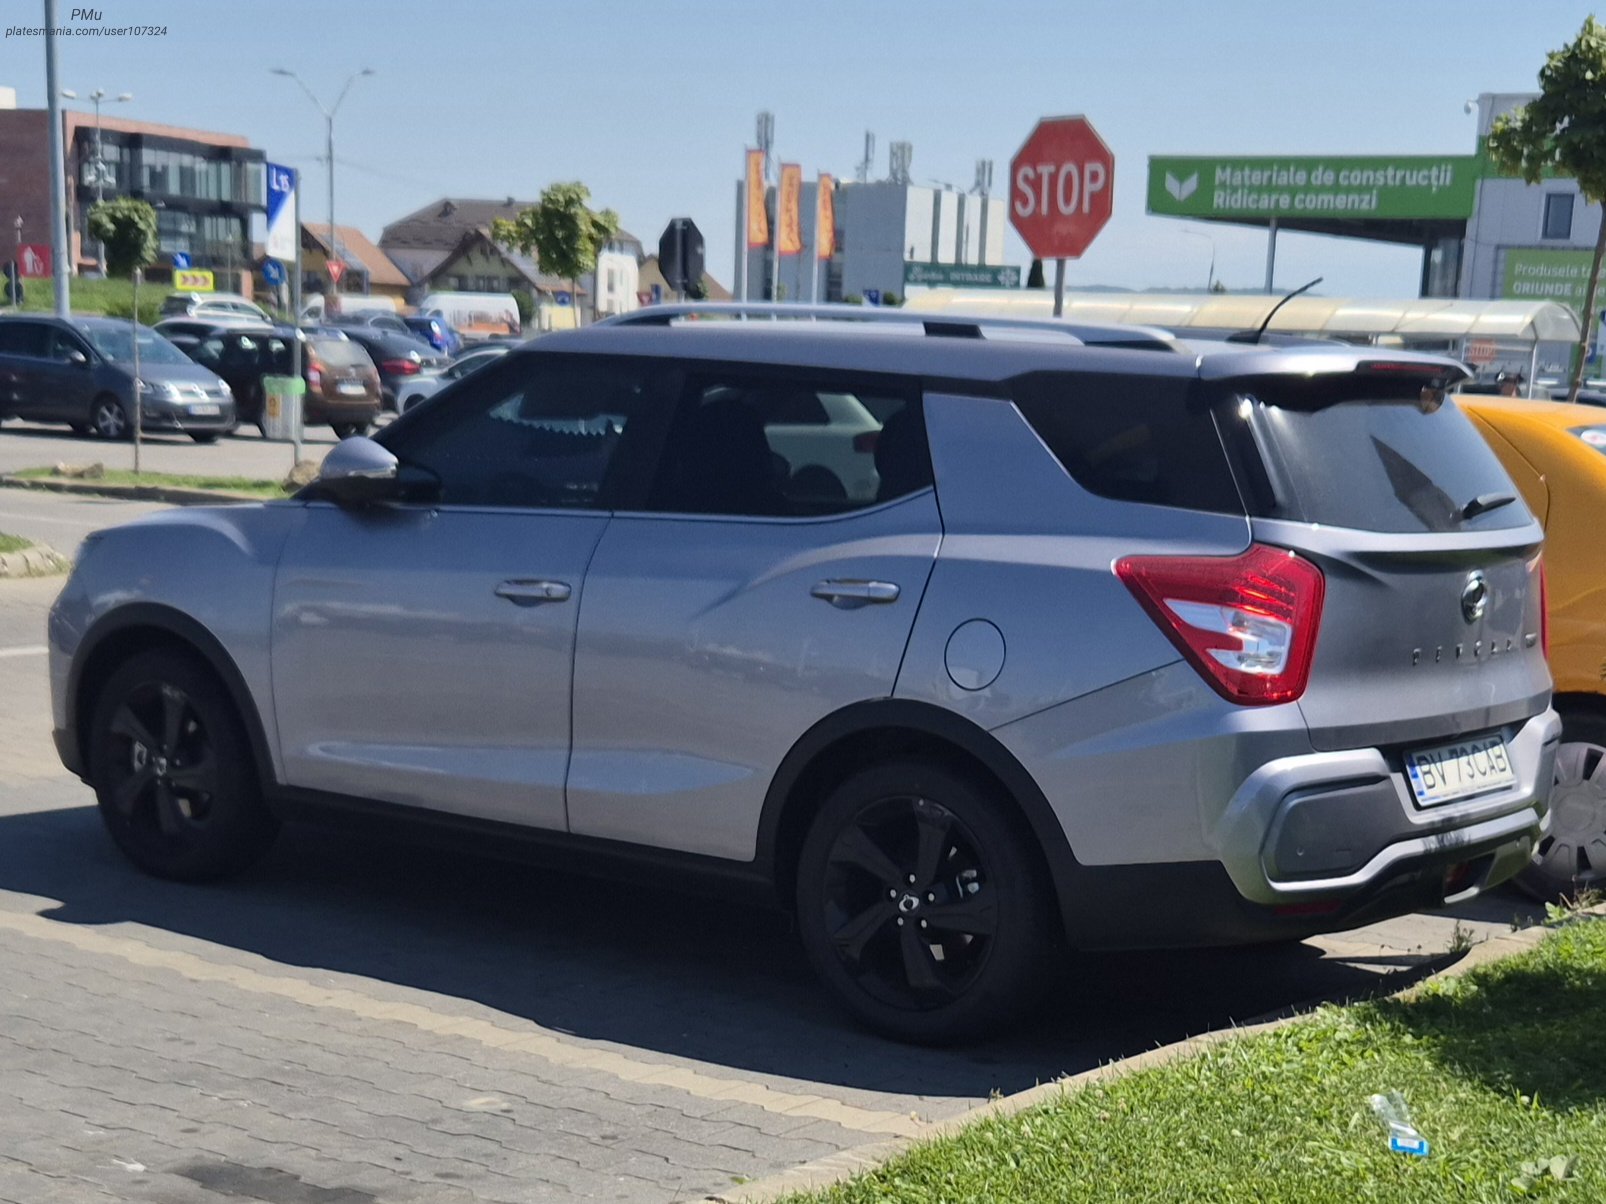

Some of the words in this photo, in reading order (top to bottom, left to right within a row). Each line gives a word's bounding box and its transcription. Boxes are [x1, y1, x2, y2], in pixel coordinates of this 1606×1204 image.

[1014, 162, 1106, 218] STOP
[1214, 164, 1306, 186] Materiale
[1310, 165, 1335, 186] de
[1338, 164, 1453, 194] construcții
[1213, 187, 1291, 209] Ridicare
[1294, 188, 1379, 210] comenzi
[1514, 262, 1578, 278] Produsele
[1513, 281, 1573, 297] ORIUNDE
[1417, 751, 1447, 790] BV
